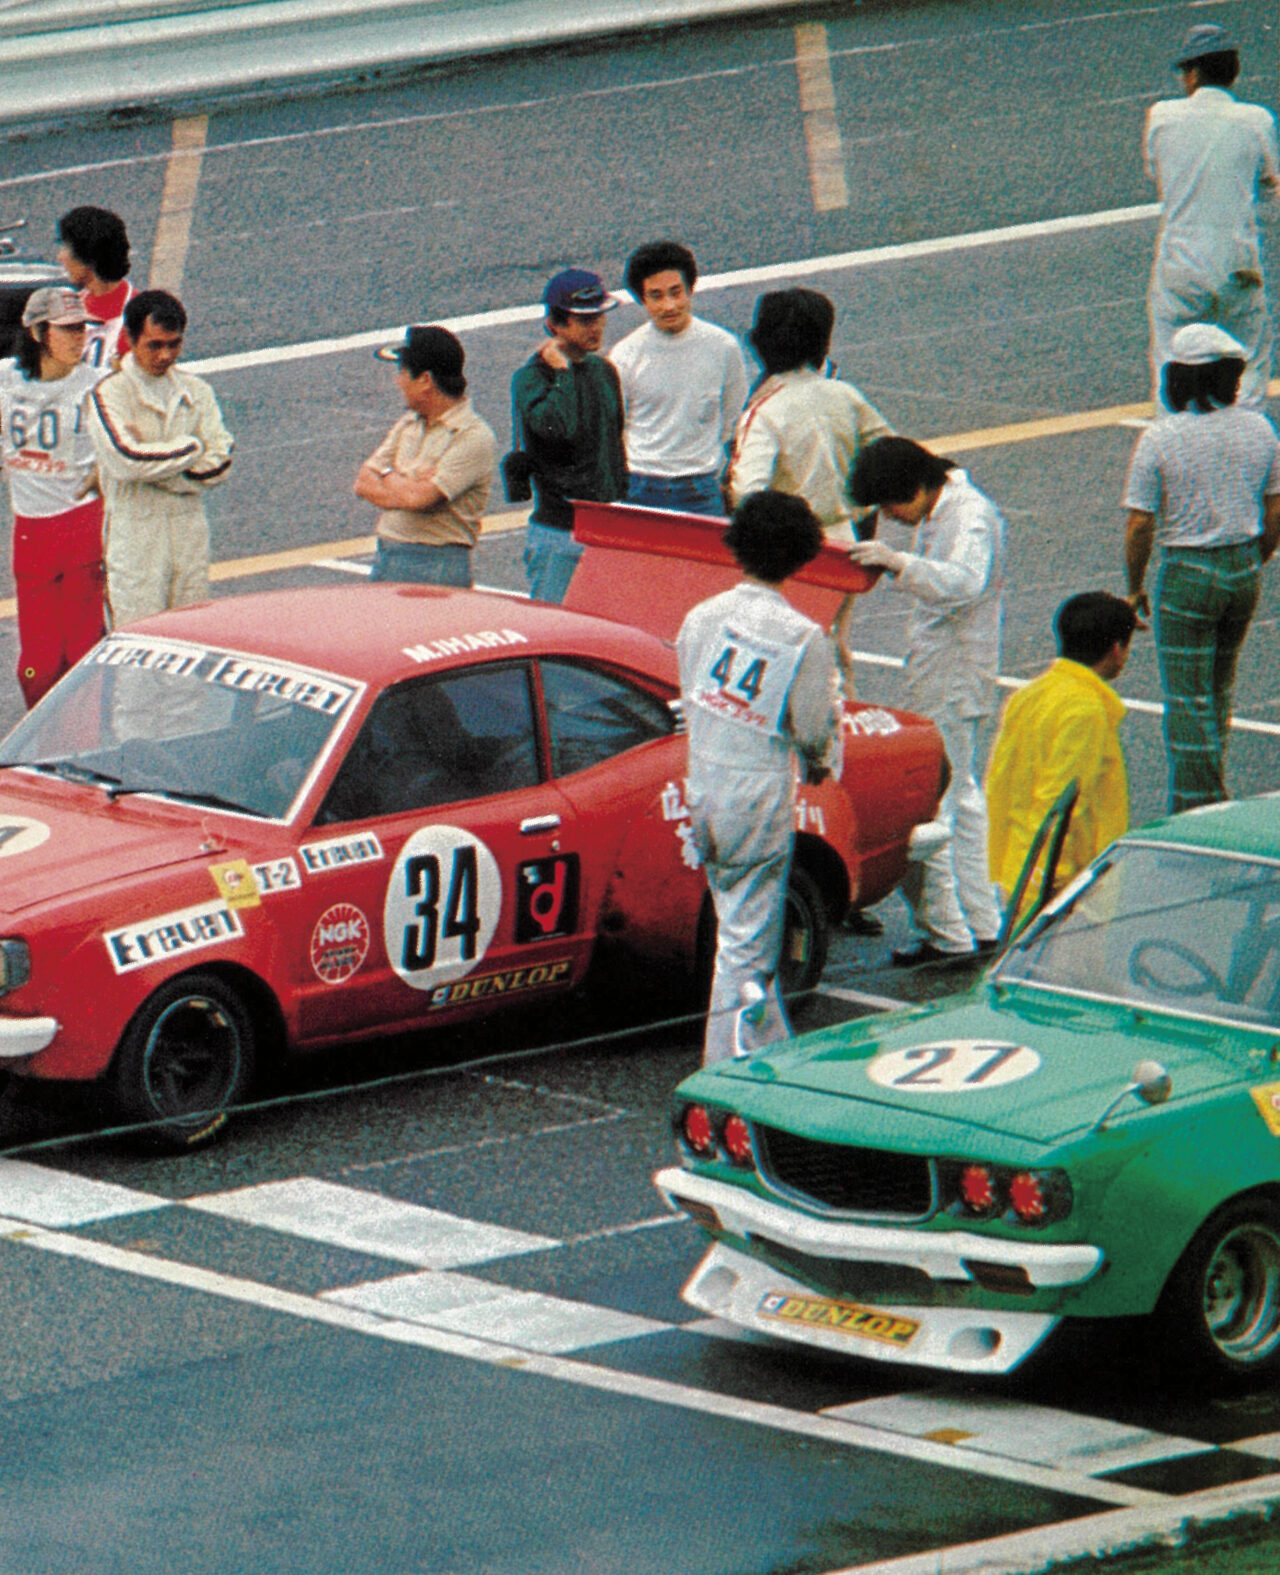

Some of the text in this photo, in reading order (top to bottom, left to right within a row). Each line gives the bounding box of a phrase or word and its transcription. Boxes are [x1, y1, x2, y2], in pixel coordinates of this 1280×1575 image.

[9, 408, 60, 450] 60
[710, 647, 768, 701] 44
[255, 863, 297, 891] T-2
[401, 843, 480, 972] 34
[320, 919, 361, 947] NGK
[449, 962, 569, 1001] DUNLOP
[893, 1046, 1022, 1085] 27
[779, 1299, 917, 1338] DUNLOP
